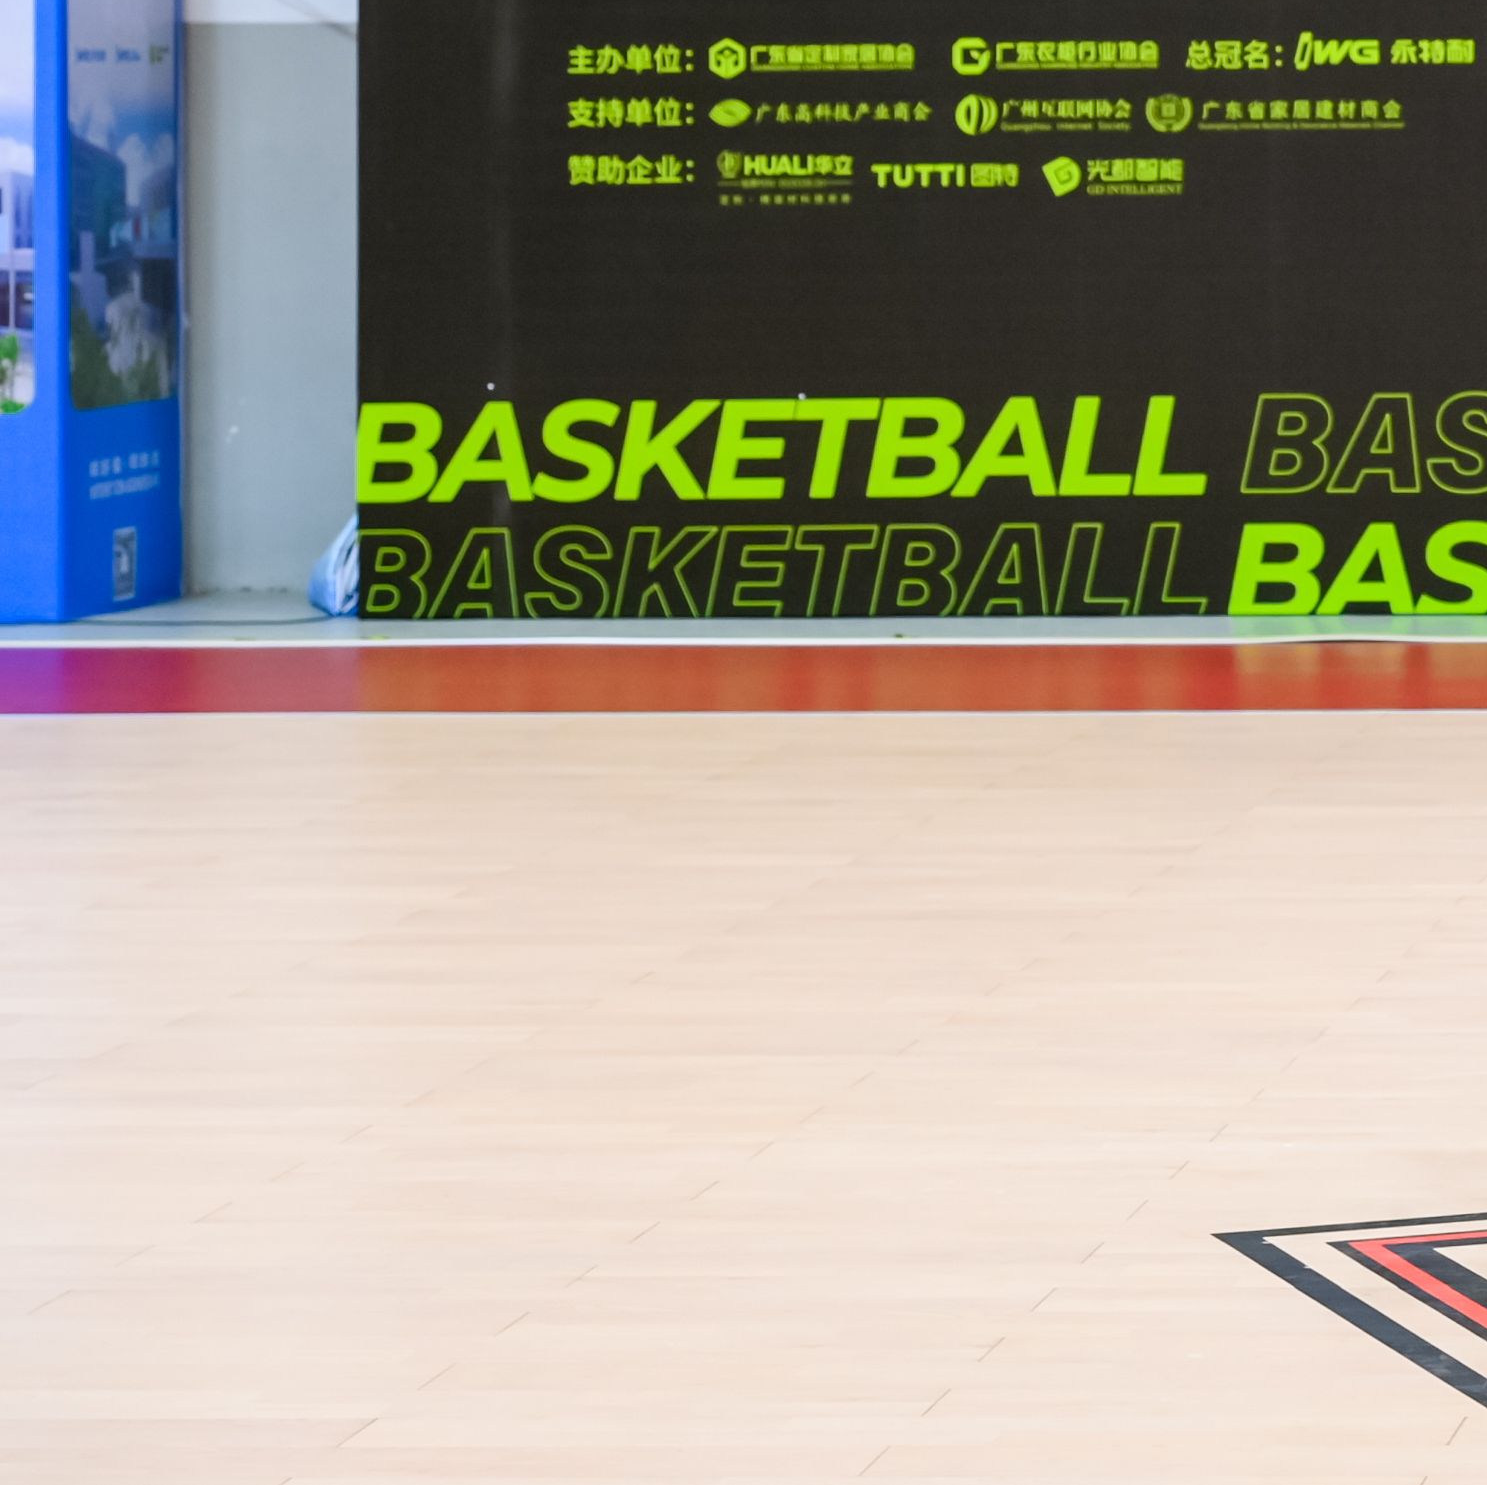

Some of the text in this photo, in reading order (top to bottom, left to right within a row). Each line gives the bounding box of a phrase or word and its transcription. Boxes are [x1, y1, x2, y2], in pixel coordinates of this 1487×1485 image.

[870, 162, 966, 188] TUTTI
[356, 394, 1208, 504] BASKETBALL
[357, 520, 1209, 617] BASKETBALL
